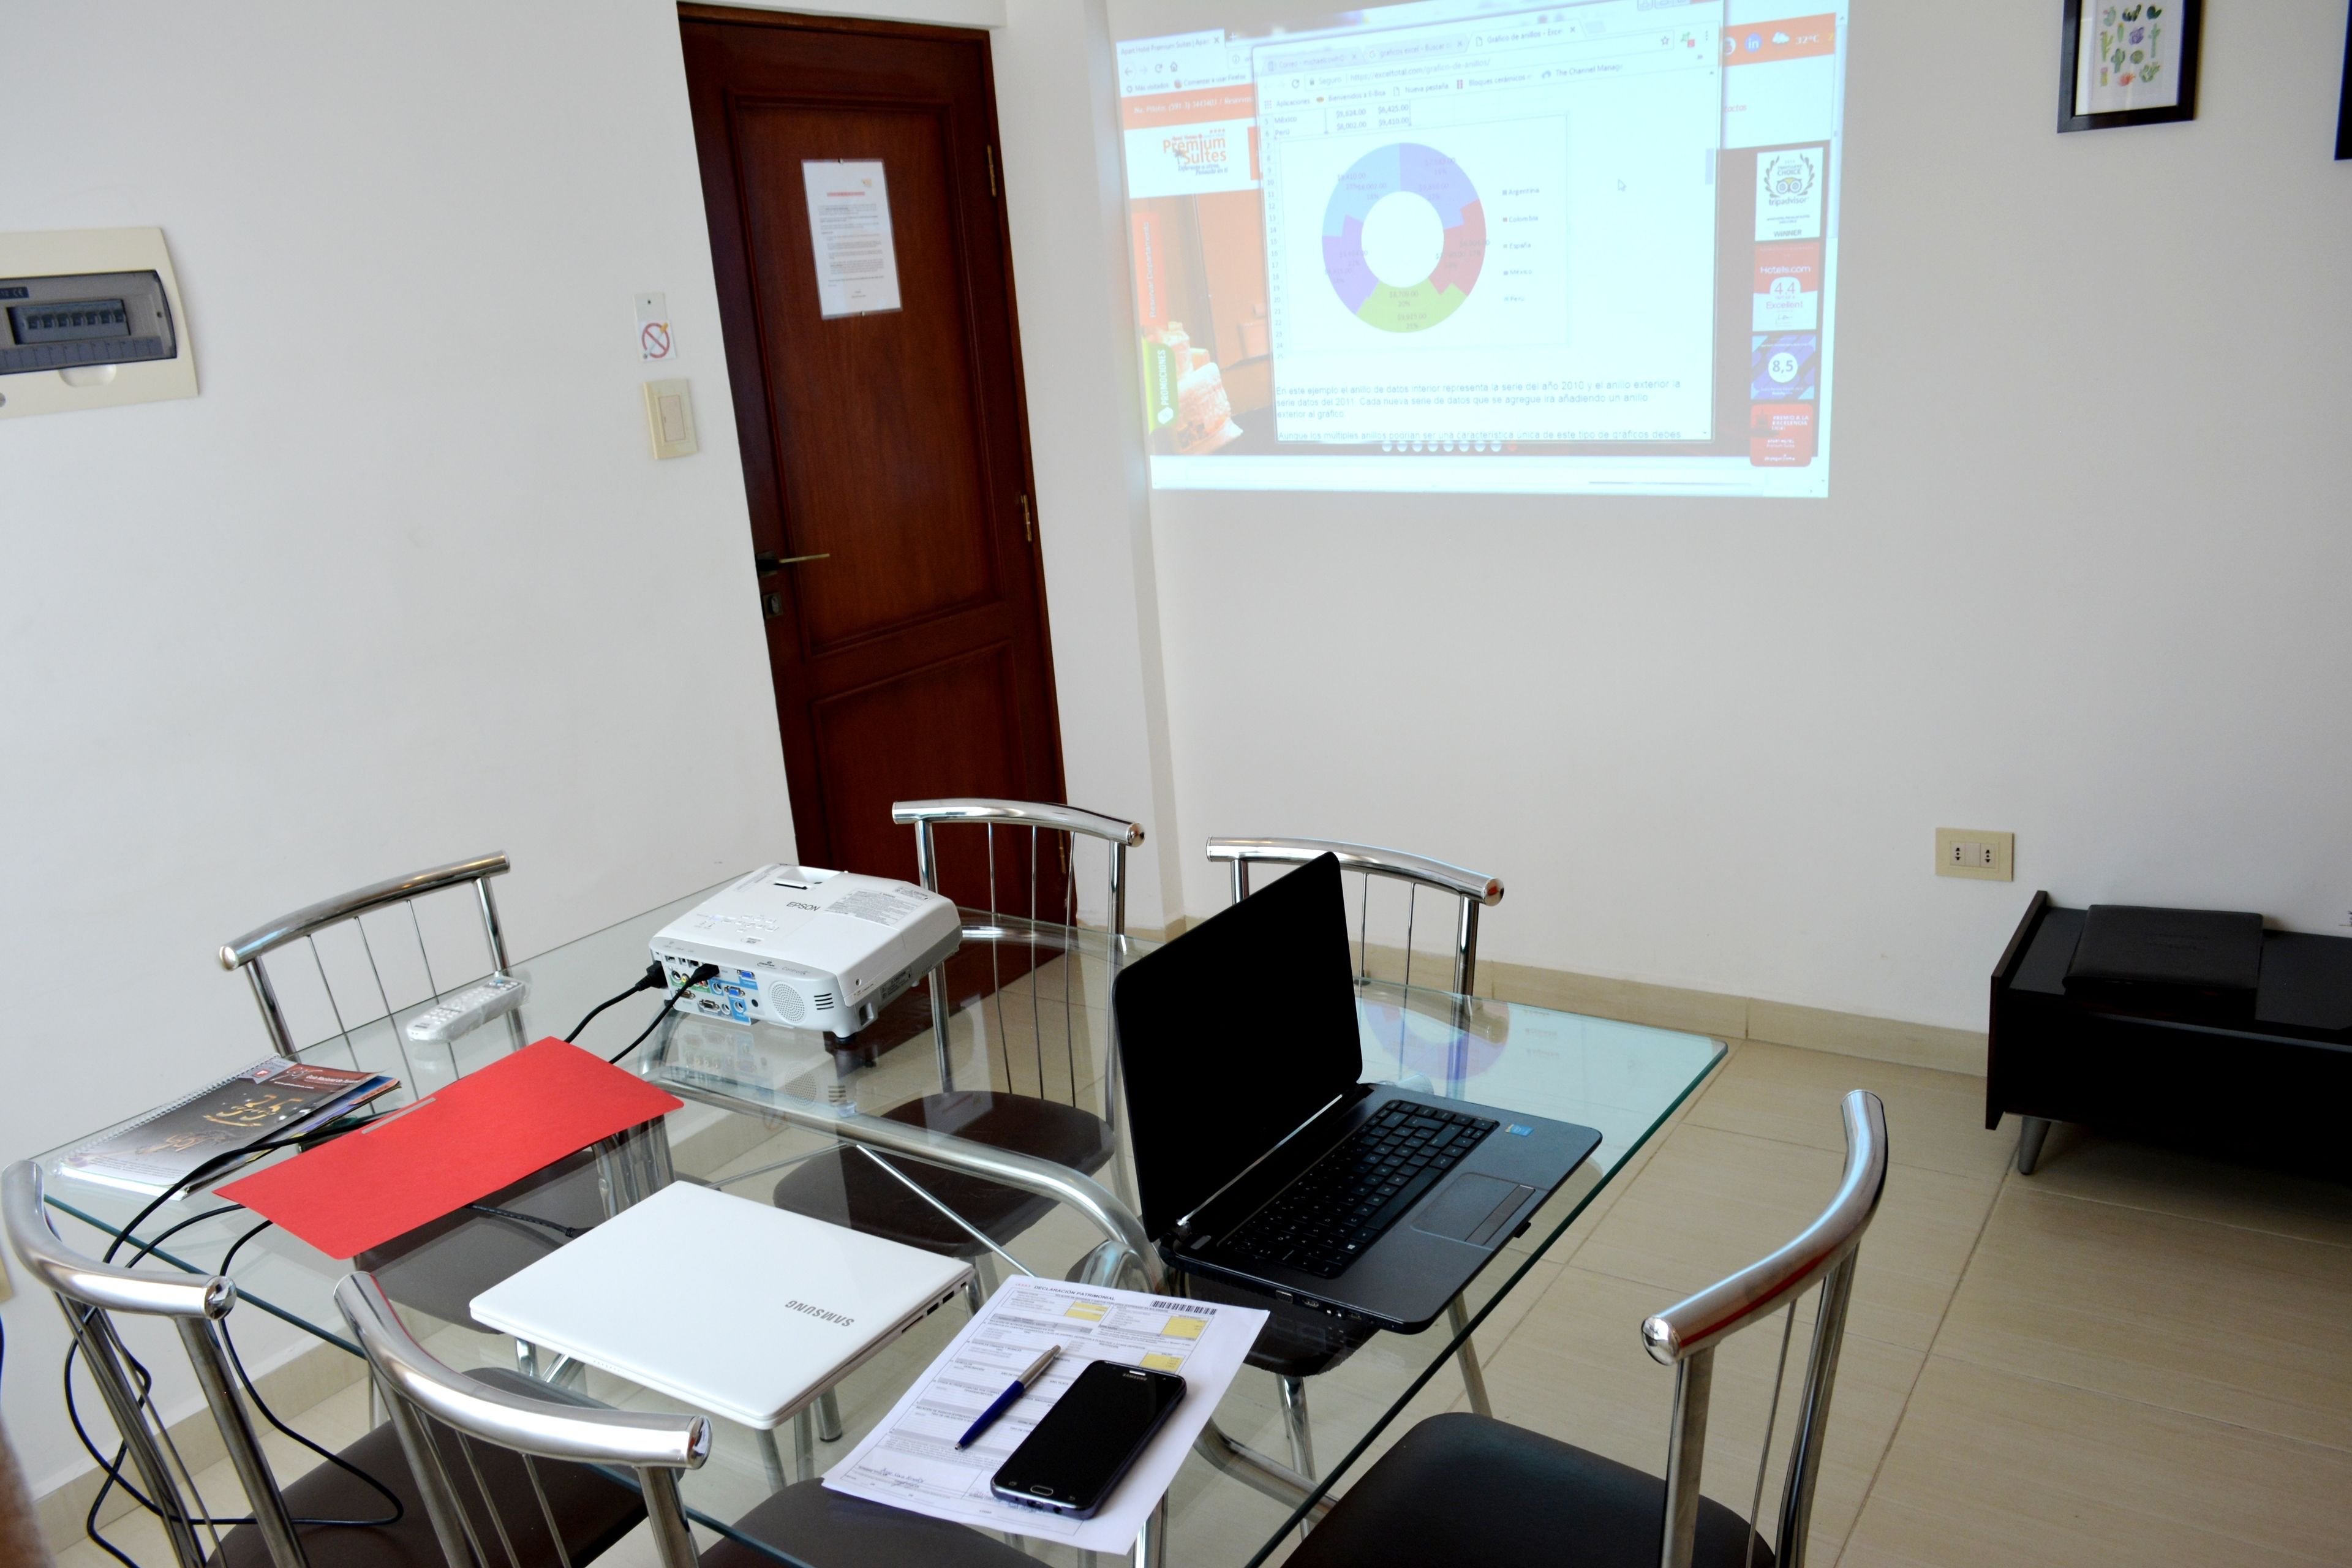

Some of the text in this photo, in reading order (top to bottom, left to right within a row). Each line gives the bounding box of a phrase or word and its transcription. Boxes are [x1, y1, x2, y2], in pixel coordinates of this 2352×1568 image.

[1151, 43, 1174, 53] Premium
[1569, 66, 1596, 75] Channel
[1183, 77, 1210, 87] Comenzar
[1227, 73, 1246, 82] Firefox
[1318, 76, 1342, 86] Seguro
[1469, 74, 1526, 88] Bloques cerámicos
[1146, 81, 1169, 90] visitados
[1425, 82, 1449, 92] pestaña
[1328, 92, 1362, 102] Bienvenidos
[1276, 98, 1310, 108] Aplicaciones
[1163, 137, 1226, 154] Premium
[1183, 151, 1227, 165] Suites
[1509, 187, 1540, 197] Argentina
[1768, 196, 1807, 206] tripadvisor
[1509, 214, 1539, 223] Colombia
[1509, 241, 1531, 249] España
[1760, 265, 1811, 274] Hotels.com
[1766, 300, 1803, 309] Excellent
[1773, 359, 1794, 374] 8,5
[1158, 349, 1169, 405] PROMOCIONES
[1276, 387, 1286, 396] En
[1307, 386, 1338, 397] ejemplo
[1341, 385, 1348, 394] el
[1350, 385, 1371, 394] anillo
[1373, 385, 1384, 394] de
[1386, 385, 1409, 393] datos
[1411, 384, 1440, 393] interior
[1442, 382, 1488, 394] representa
[1491, 383, 1499, 391] la
[1502, 383, 1523, 391] serie
[1525, 382, 1539, 391] del
[1542, 381, 1559, 390] año
[1561, 381, 1584, 390] 2010
[1586, 383, 1593, 392] y
[1595, 381, 1603, 390] el
[1606, 380, 1630, 390] anillo
[1633, 380, 1669, 389] exterior
[1672, 380, 1681, 388] la
[1276, 398, 1295, 407] serie
[1297, 398, 1319, 407] datos
[1321, 398, 1333, 406] del
[1359, 397, 1381, 405] Cada
[1411, 397, 1431, 405] serie
[1434, 396, 1444, 405] de
[1447, 396, 1470, 405] datos
[1473, 396, 1489, 405] que
[1505, 395, 1541, 406] agregue
[1558, 393, 1606, 403] añadiendo
[1623, 393, 1648, 402] anillo
[1277, 410, 1306, 418] exterior
[1308, 410, 1315, 418] al
[1278, 431, 1308, 441] Aunque
[1310, 431, 1321, 440] los
[1361, 431, 1387, 440] anillos
[1438, 431, 1454, 440] una
[1543, 430, 1554, 439] de
[1556, 431, 1576, 439] este
[1578, 430, 1595, 440] tipo
[1598, 430, 1610, 439] de
[1612, 429, 1649, 440] gráficos
[1652, 430, 1681, 439] debes
[786, 901, 821, 911] EPSON
[1034, 1285, 1115, 1302] DECLARACIÓN PATRIMONIAL
[785, 1300, 855, 1328] SAMSUNG
